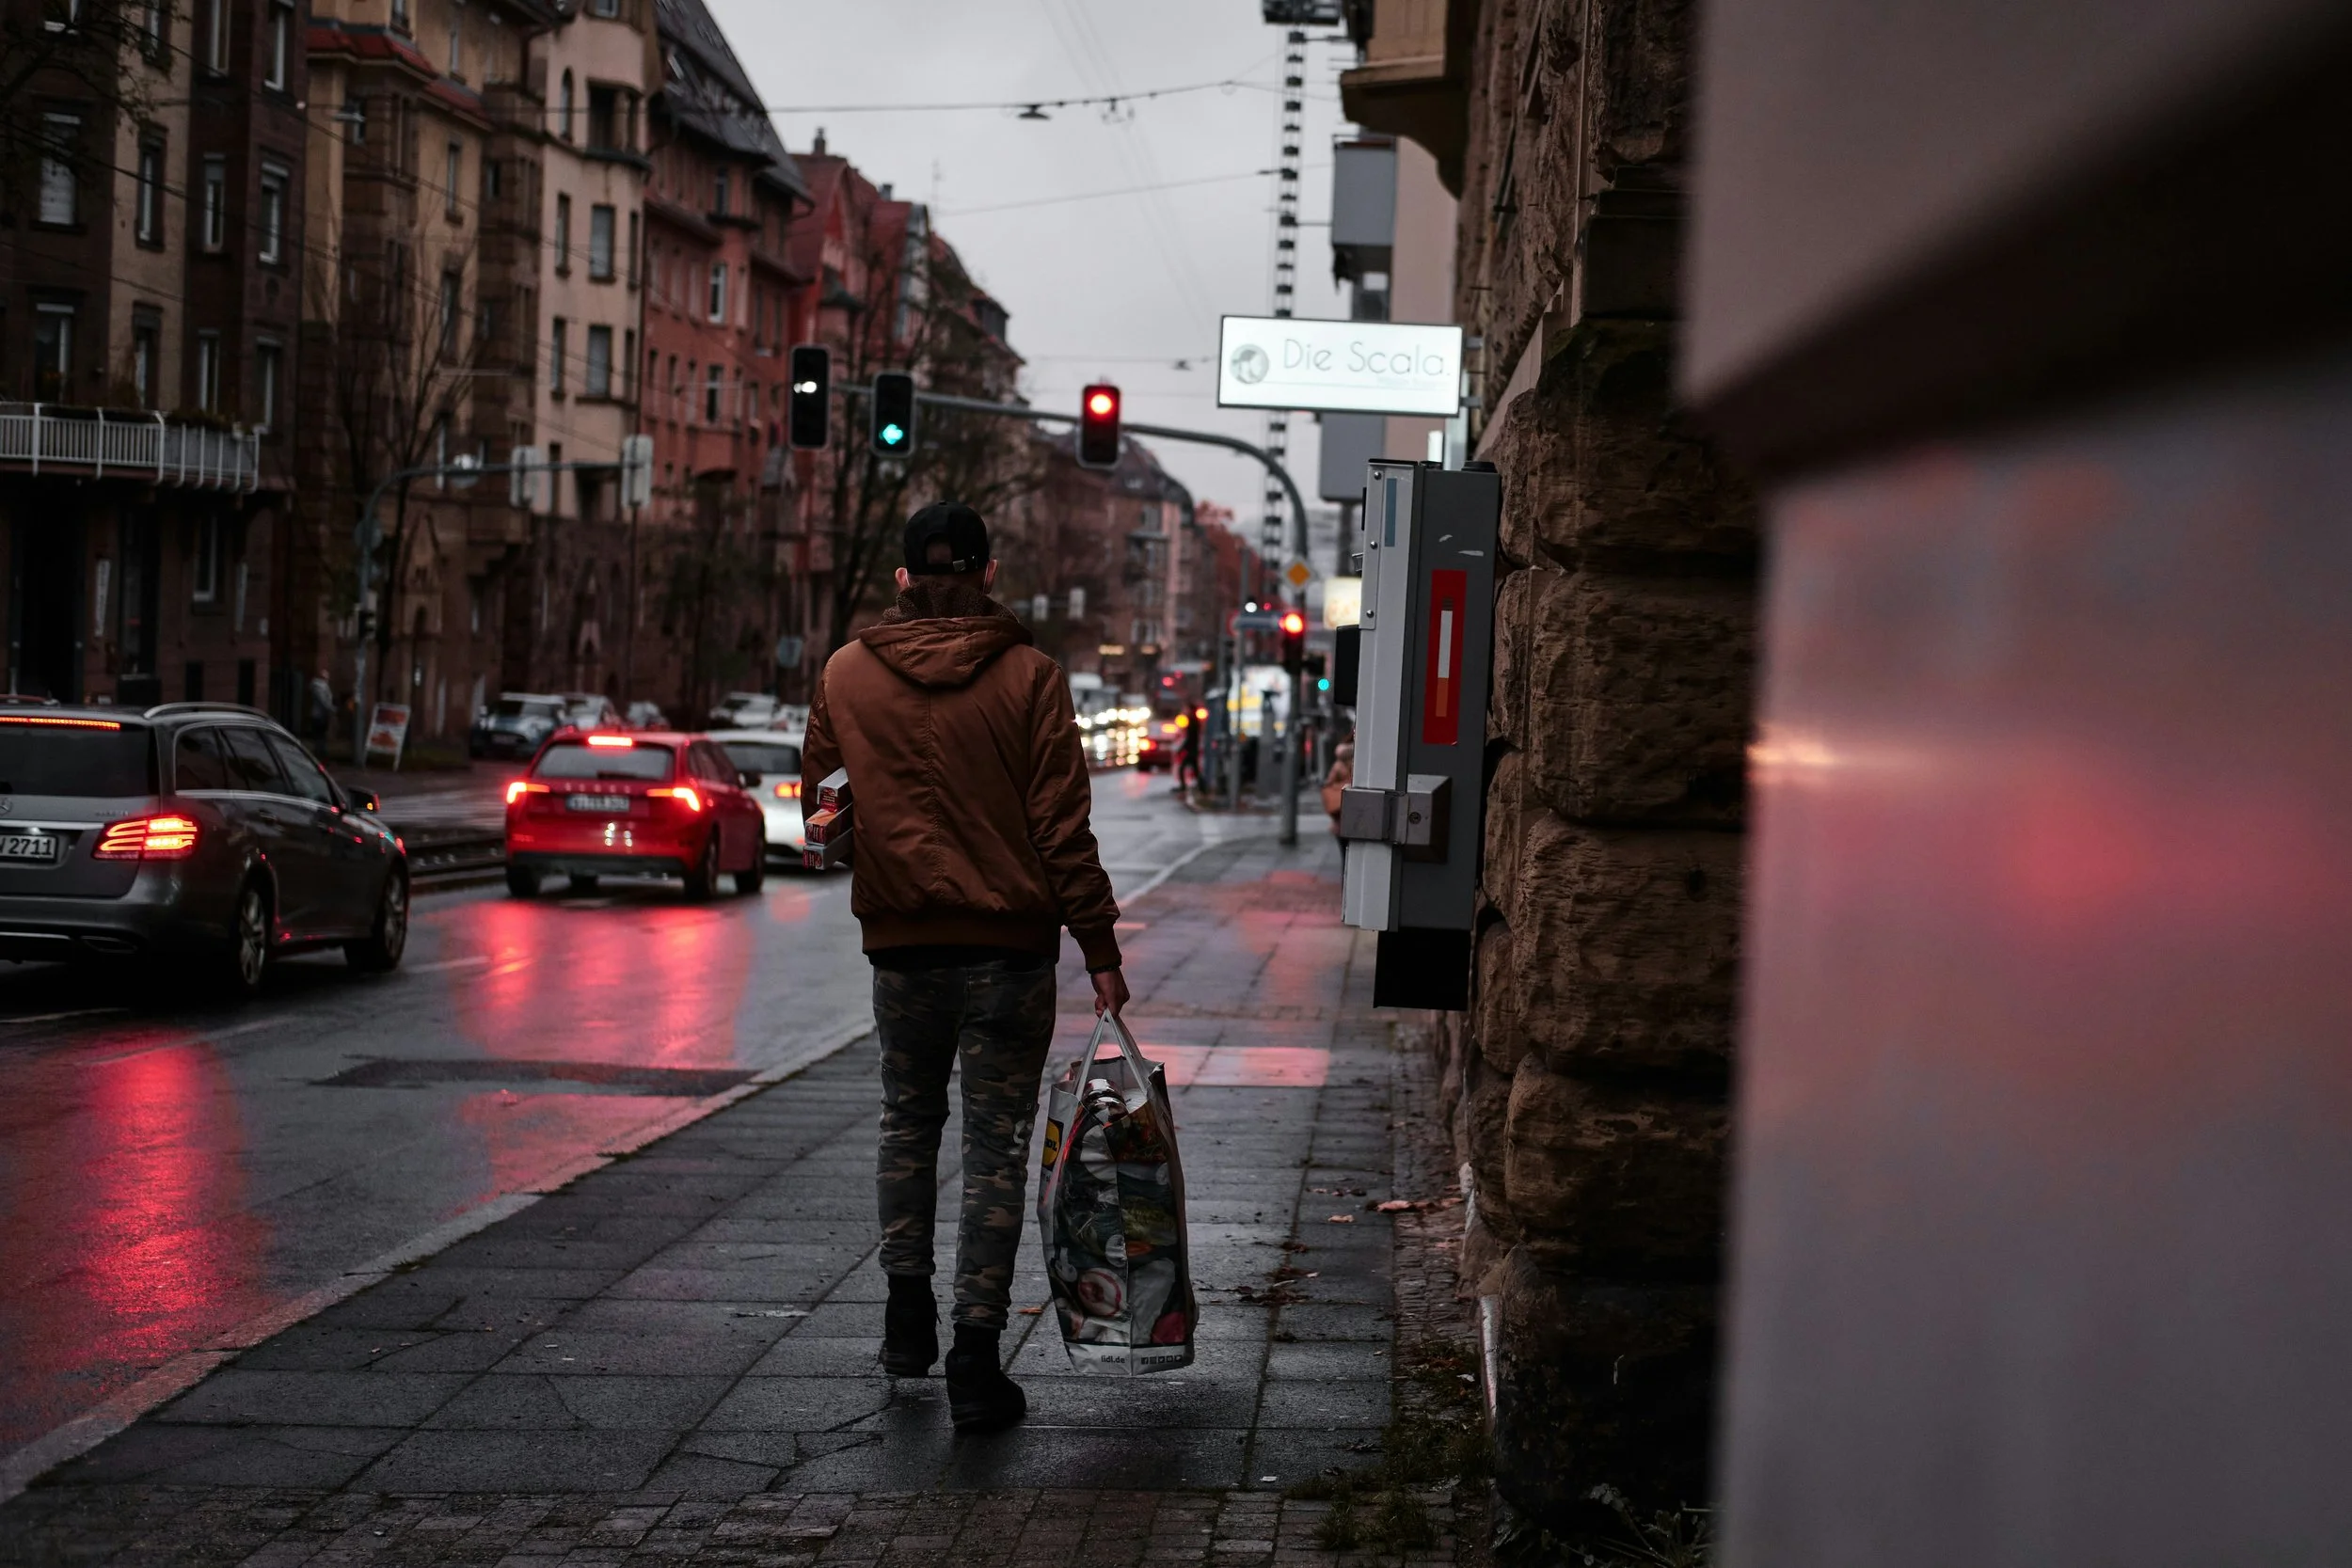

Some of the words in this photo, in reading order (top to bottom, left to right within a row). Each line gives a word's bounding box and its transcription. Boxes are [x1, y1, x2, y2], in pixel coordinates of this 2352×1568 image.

[1282, 338, 1332, 372] Die
[8, 837, 52, 855] 2711
[1101, 1354, 1125, 1364] lidl.de
